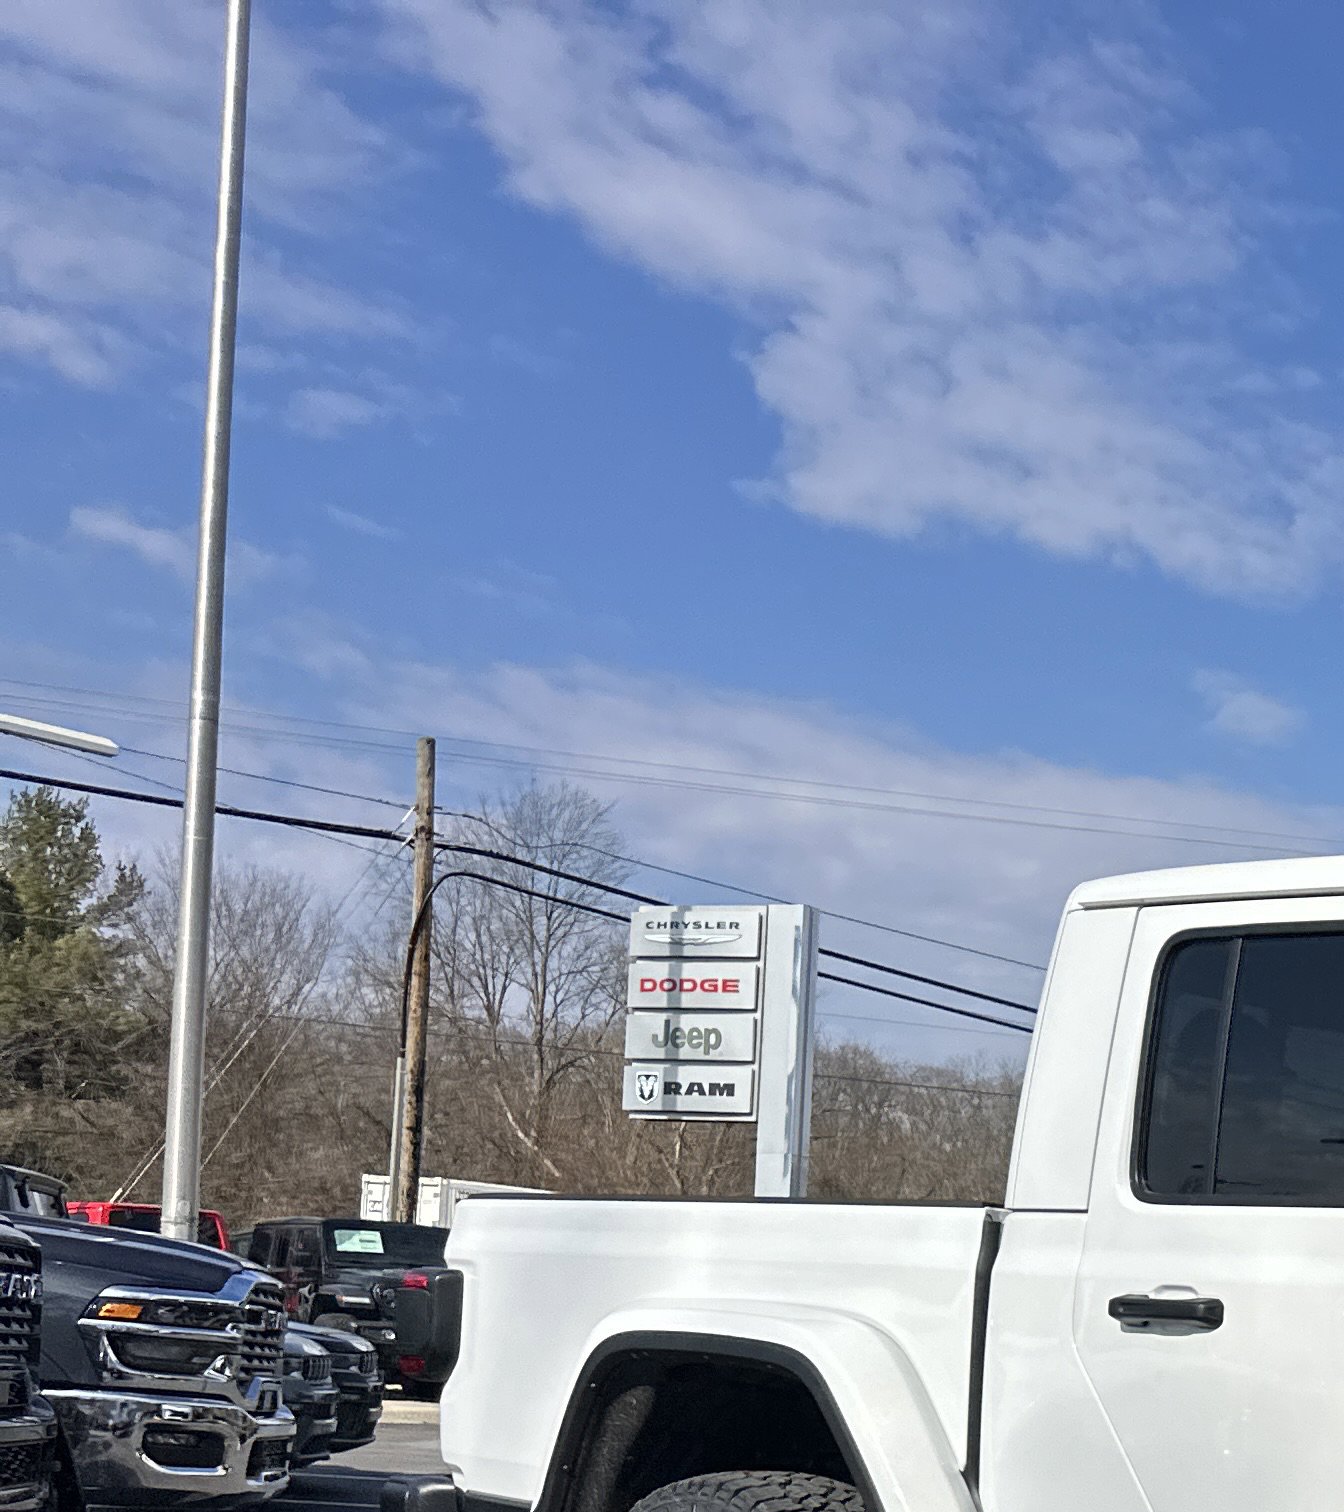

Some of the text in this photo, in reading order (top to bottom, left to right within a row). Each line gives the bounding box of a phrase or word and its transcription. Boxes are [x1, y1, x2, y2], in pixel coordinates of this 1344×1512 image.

[645, 920, 741, 930] CHRYSLER
[639, 977, 741, 994] DODGE
[651, 1018, 723, 1056] Jeep
[663, 1080, 736, 1097] RAM
